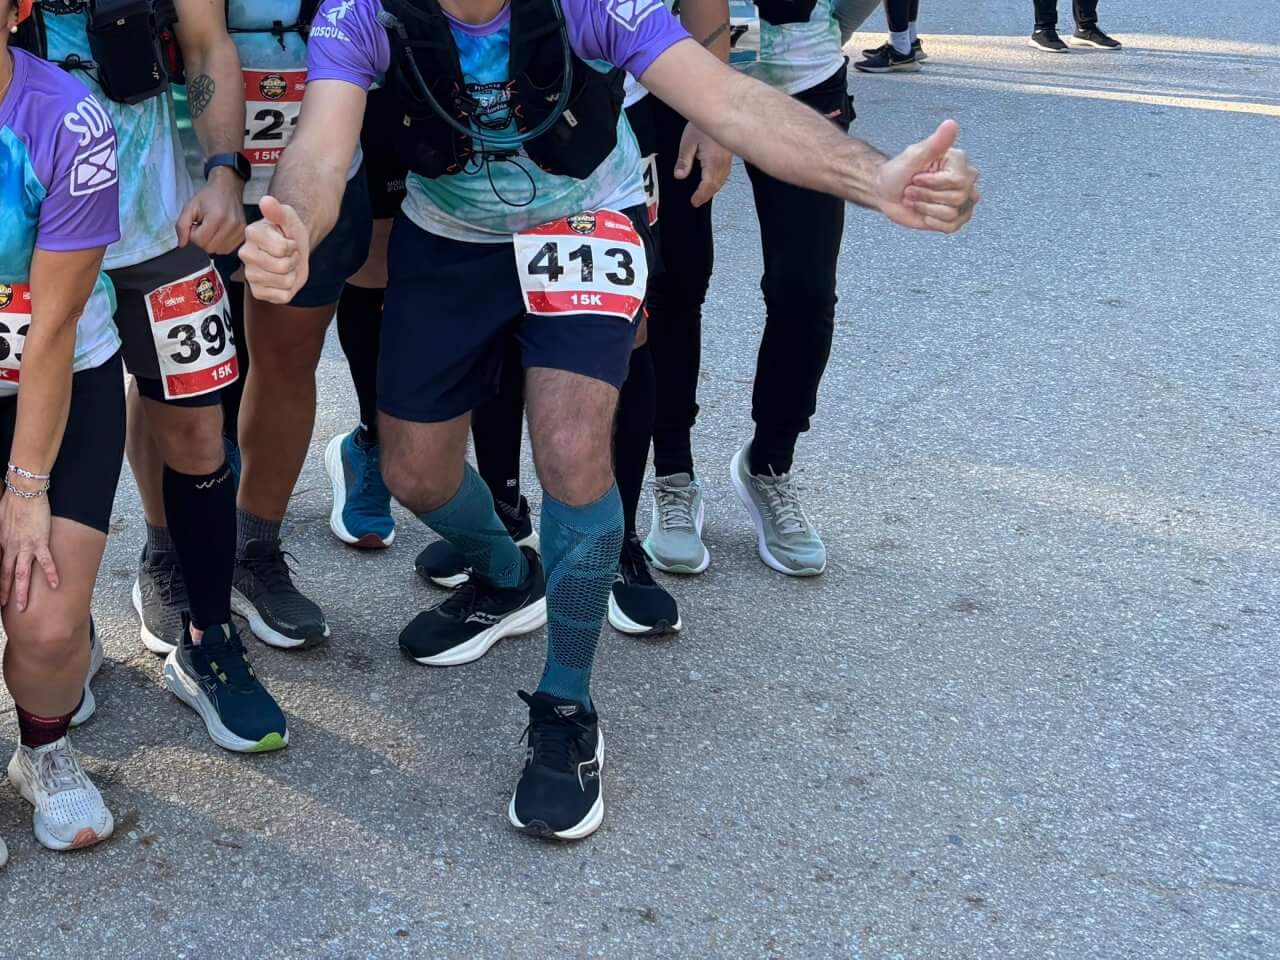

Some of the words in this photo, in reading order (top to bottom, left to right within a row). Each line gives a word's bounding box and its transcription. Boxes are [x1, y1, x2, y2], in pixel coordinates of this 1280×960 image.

[254, 151, 280, 160] 15K
[528, 242, 635, 286] 413
[570, 294, 603, 305] 15K
[212, 363, 232, 381] 15K
